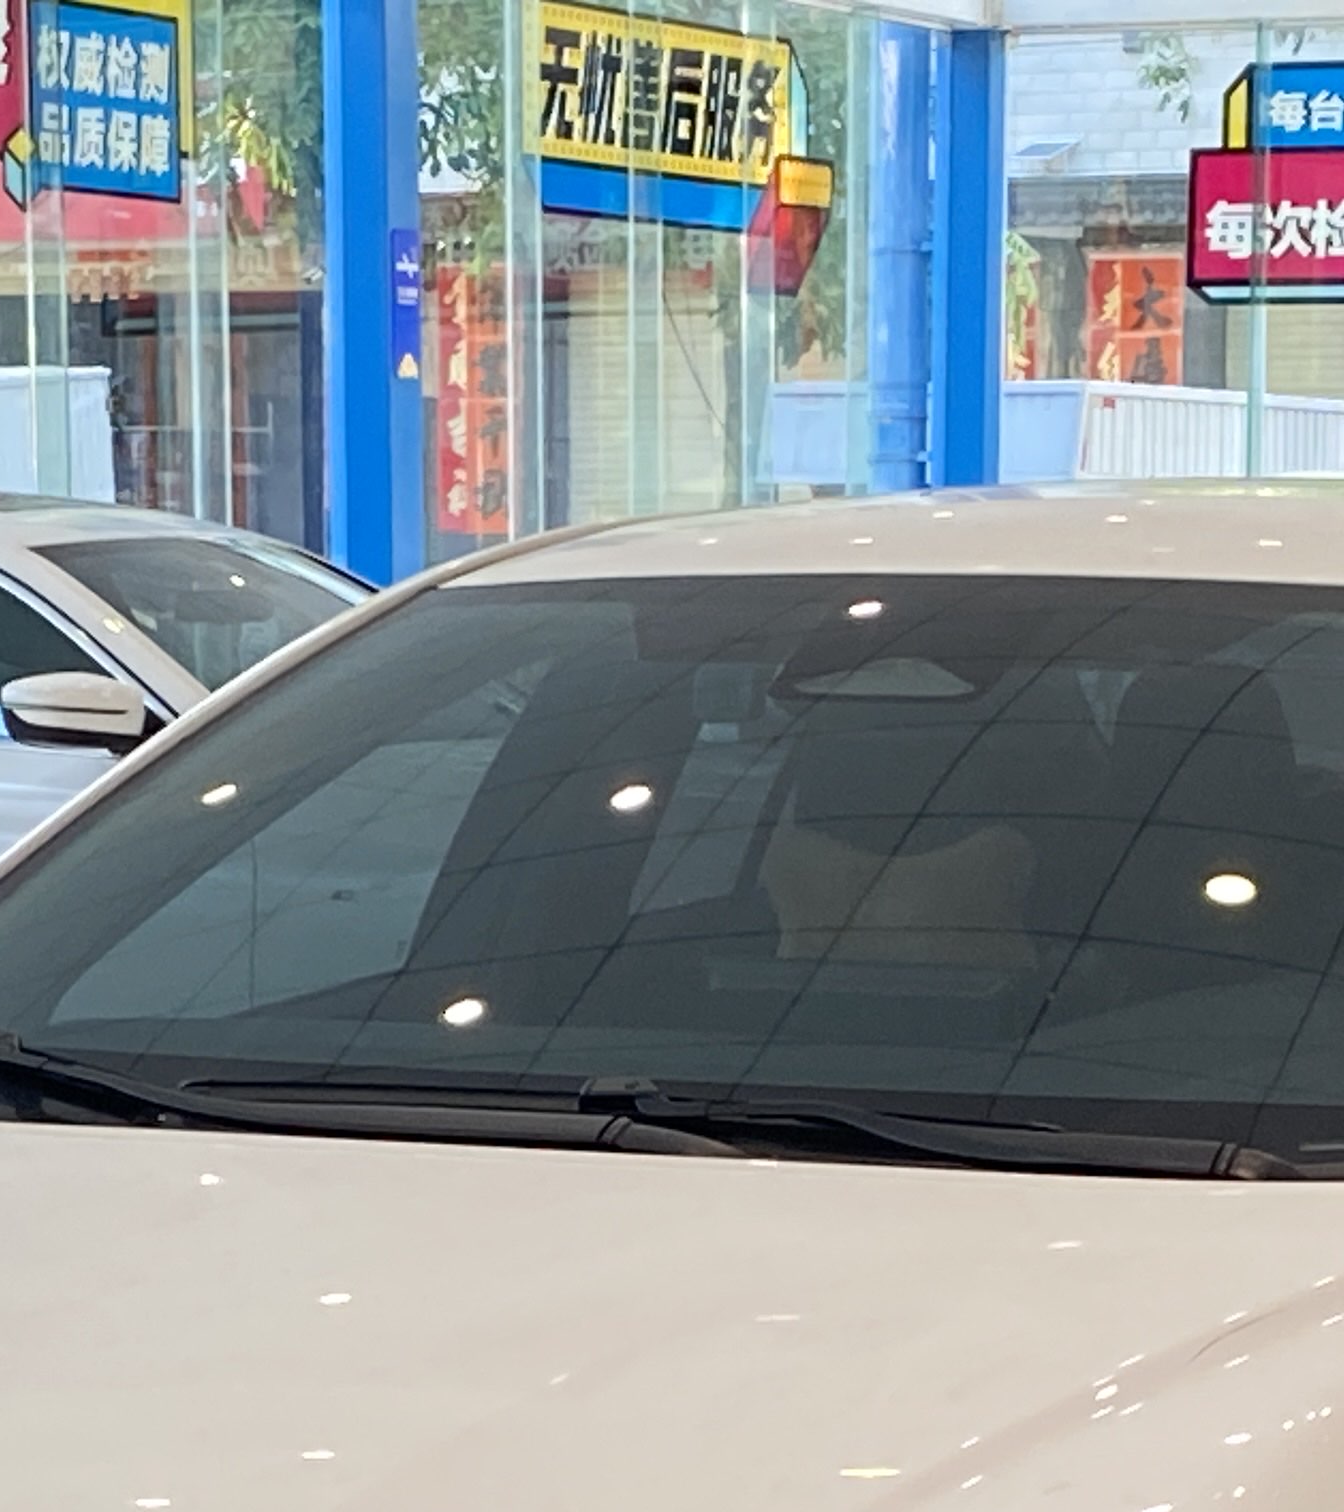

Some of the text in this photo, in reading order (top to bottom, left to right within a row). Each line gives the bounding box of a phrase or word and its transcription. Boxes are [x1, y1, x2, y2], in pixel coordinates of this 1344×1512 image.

[37, 24, 171, 103] 权威检测
[540, 24, 782, 168] 无忧售后服务
[38, 103, 171, 178] 品质保障
